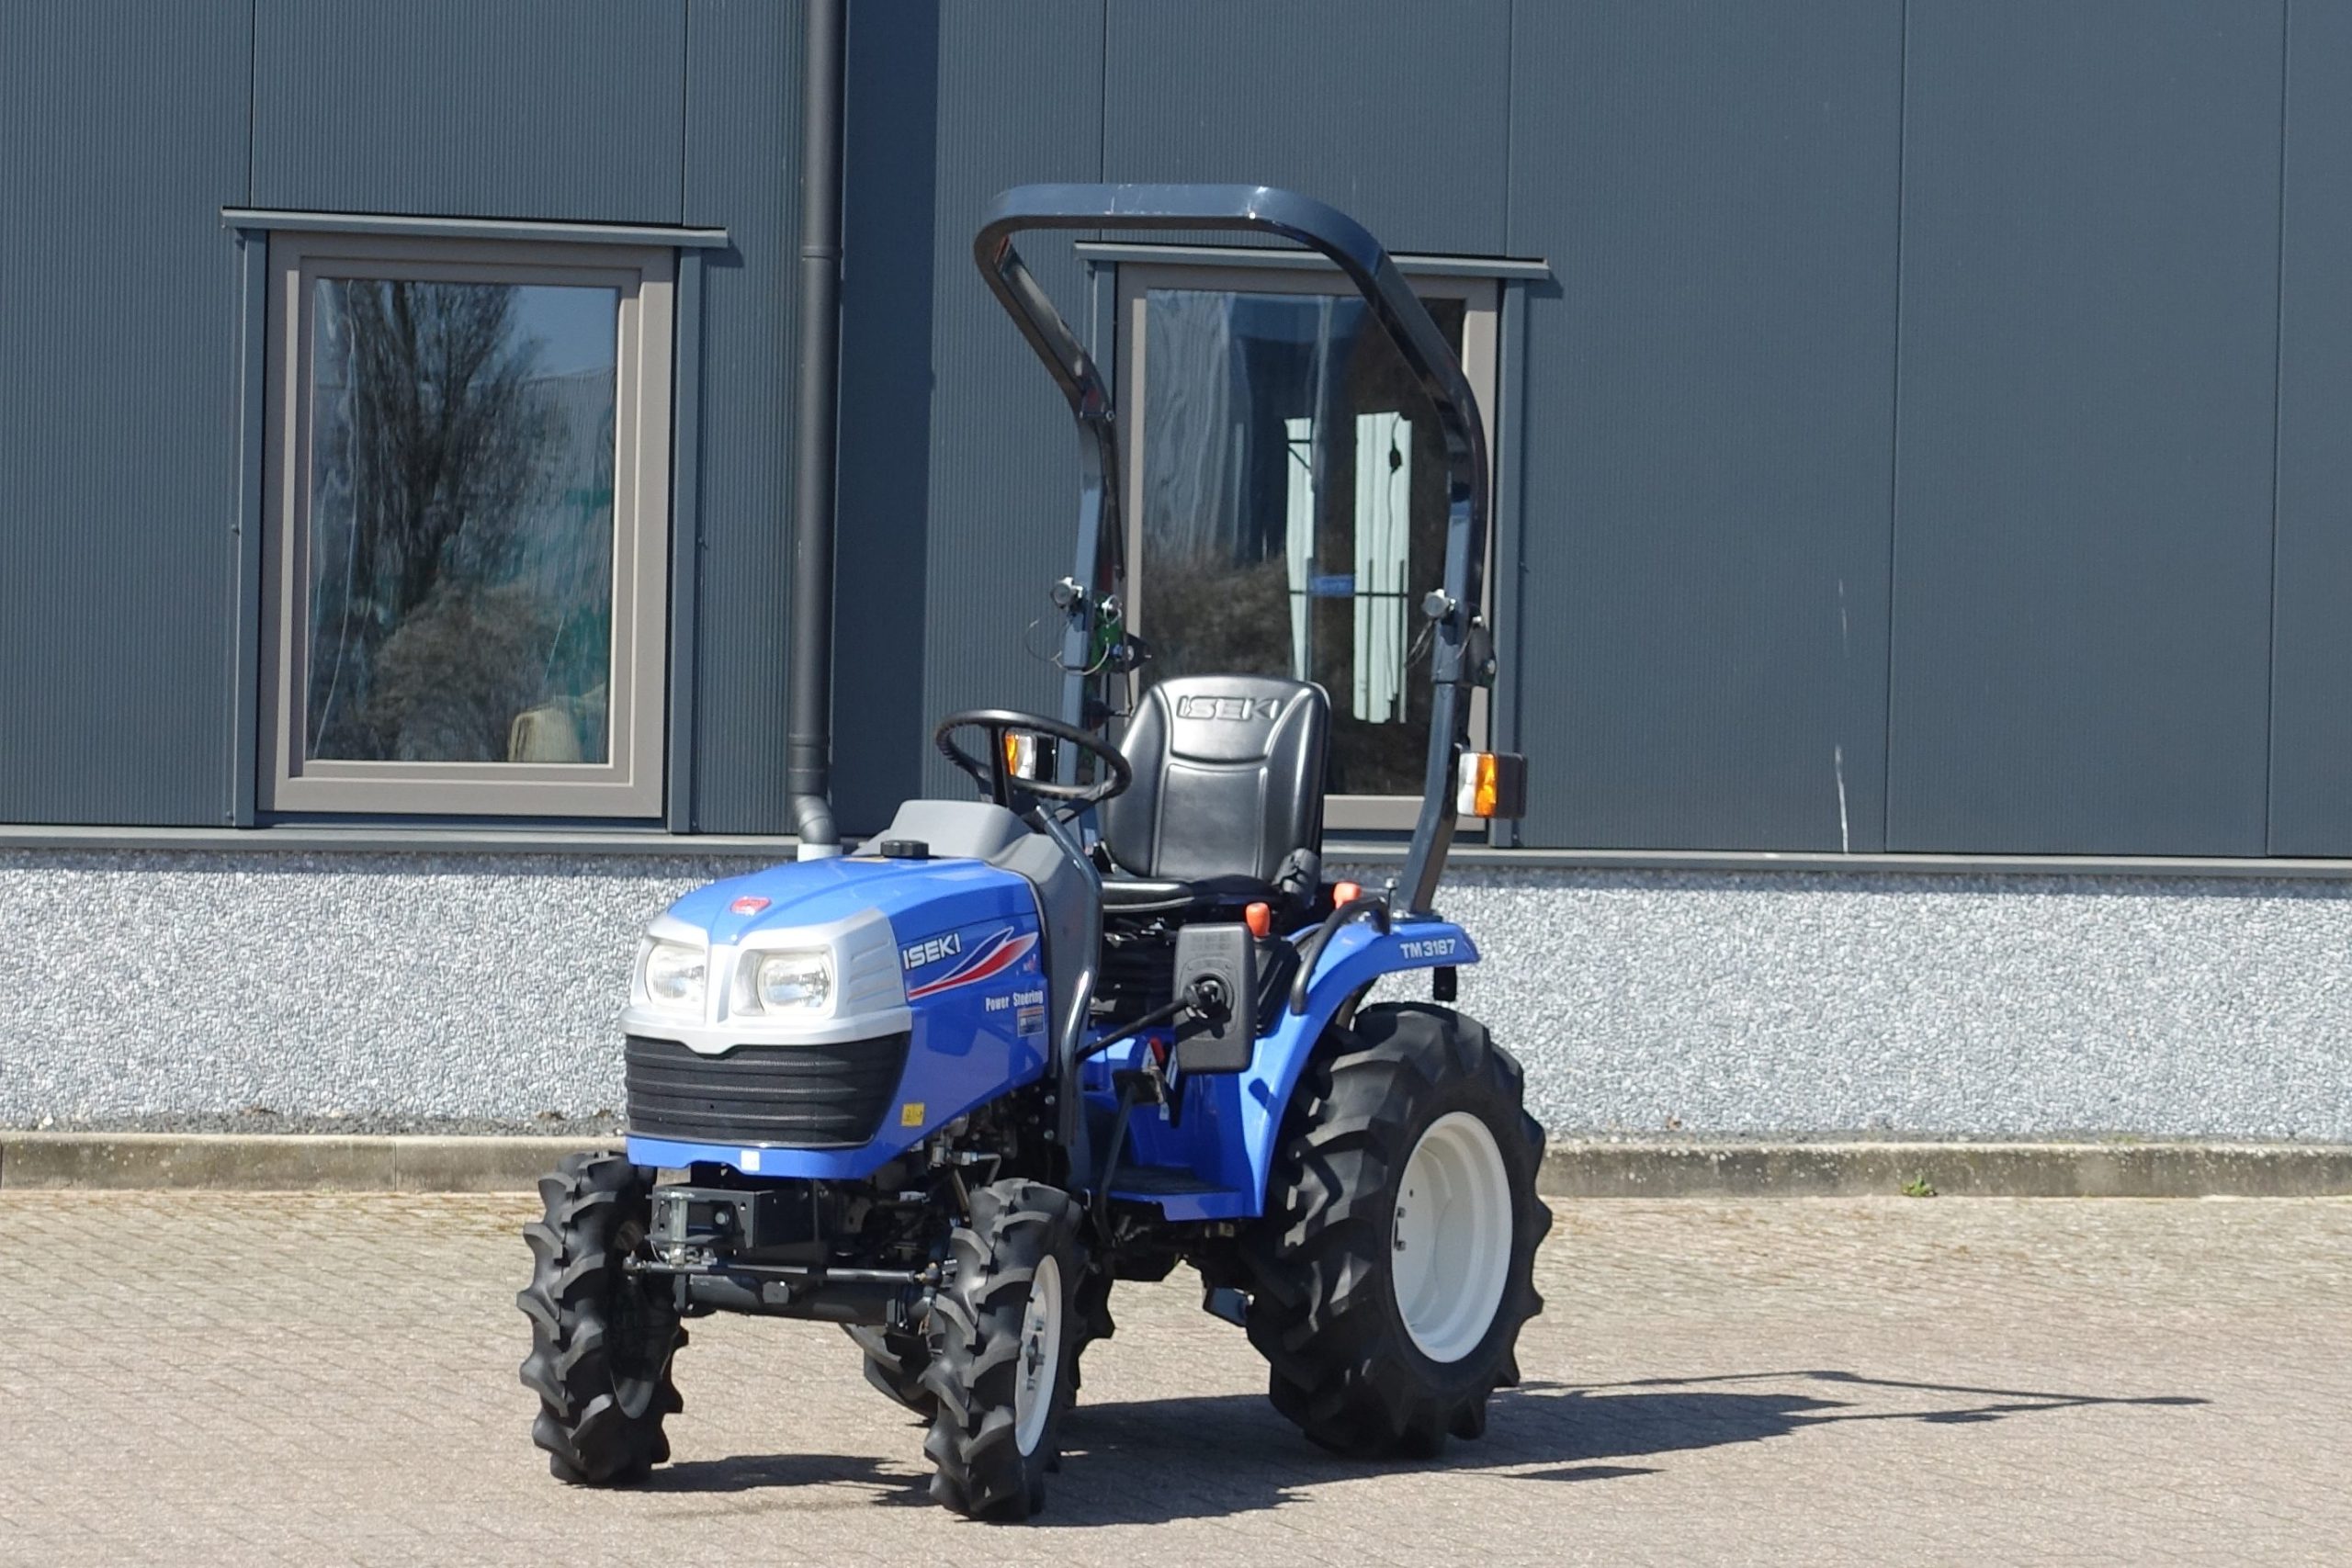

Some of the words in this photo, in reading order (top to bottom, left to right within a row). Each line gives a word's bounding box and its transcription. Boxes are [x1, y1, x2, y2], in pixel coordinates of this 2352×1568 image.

[1176, 695, 1280, 721] ISEKI
[902, 933, 961, 970] ISEKI
[986, 997, 1009, 1012] Power
[1012, 989, 1044, 1007] Steering
